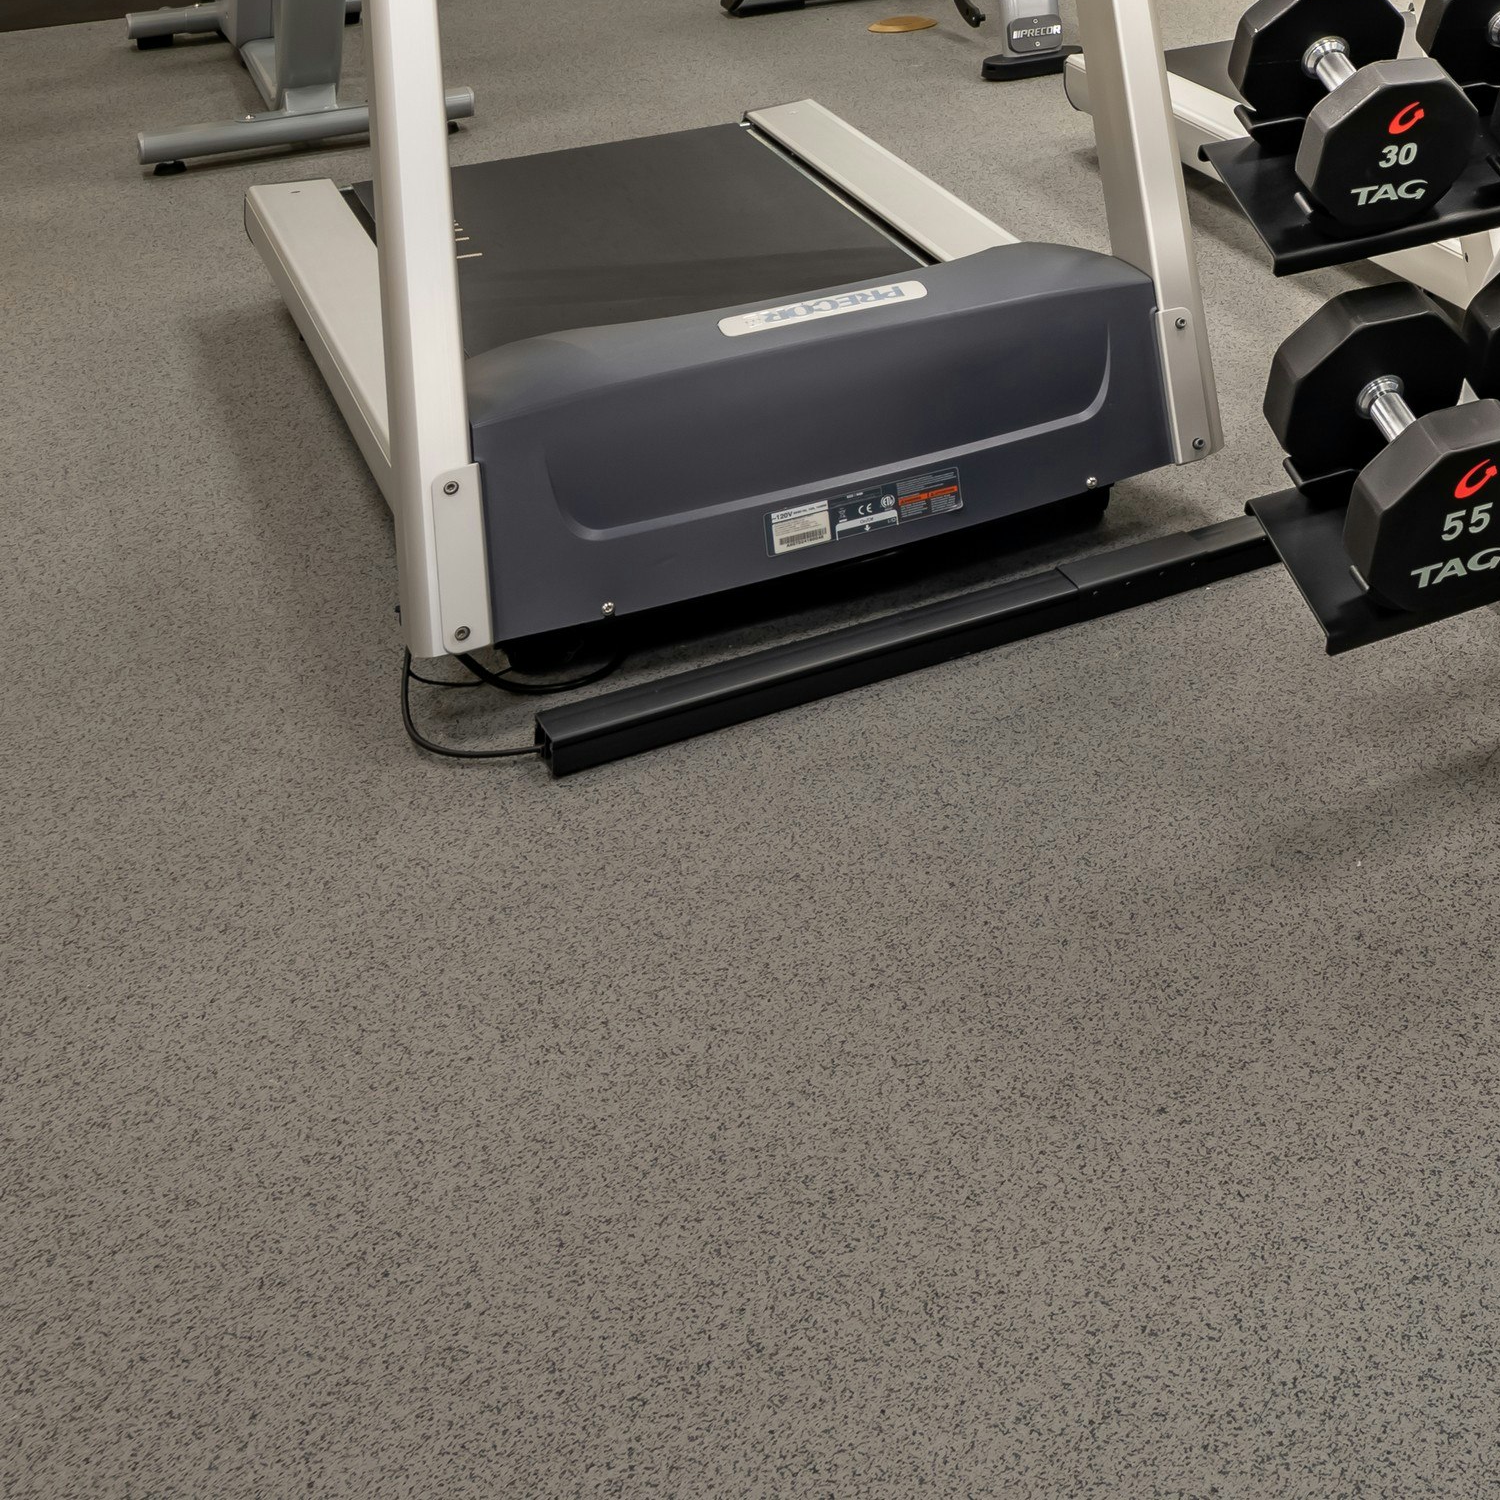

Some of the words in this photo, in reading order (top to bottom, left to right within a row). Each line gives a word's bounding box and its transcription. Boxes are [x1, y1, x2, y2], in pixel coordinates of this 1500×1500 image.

[1020, 25, 1062, 38] PRECOR
[1379, 143, 1417, 167] 30
[1351, 180, 1427, 205] TAG
[763, 286, 905, 324] PRECOR
[1442, 503, 1493, 540] 55
